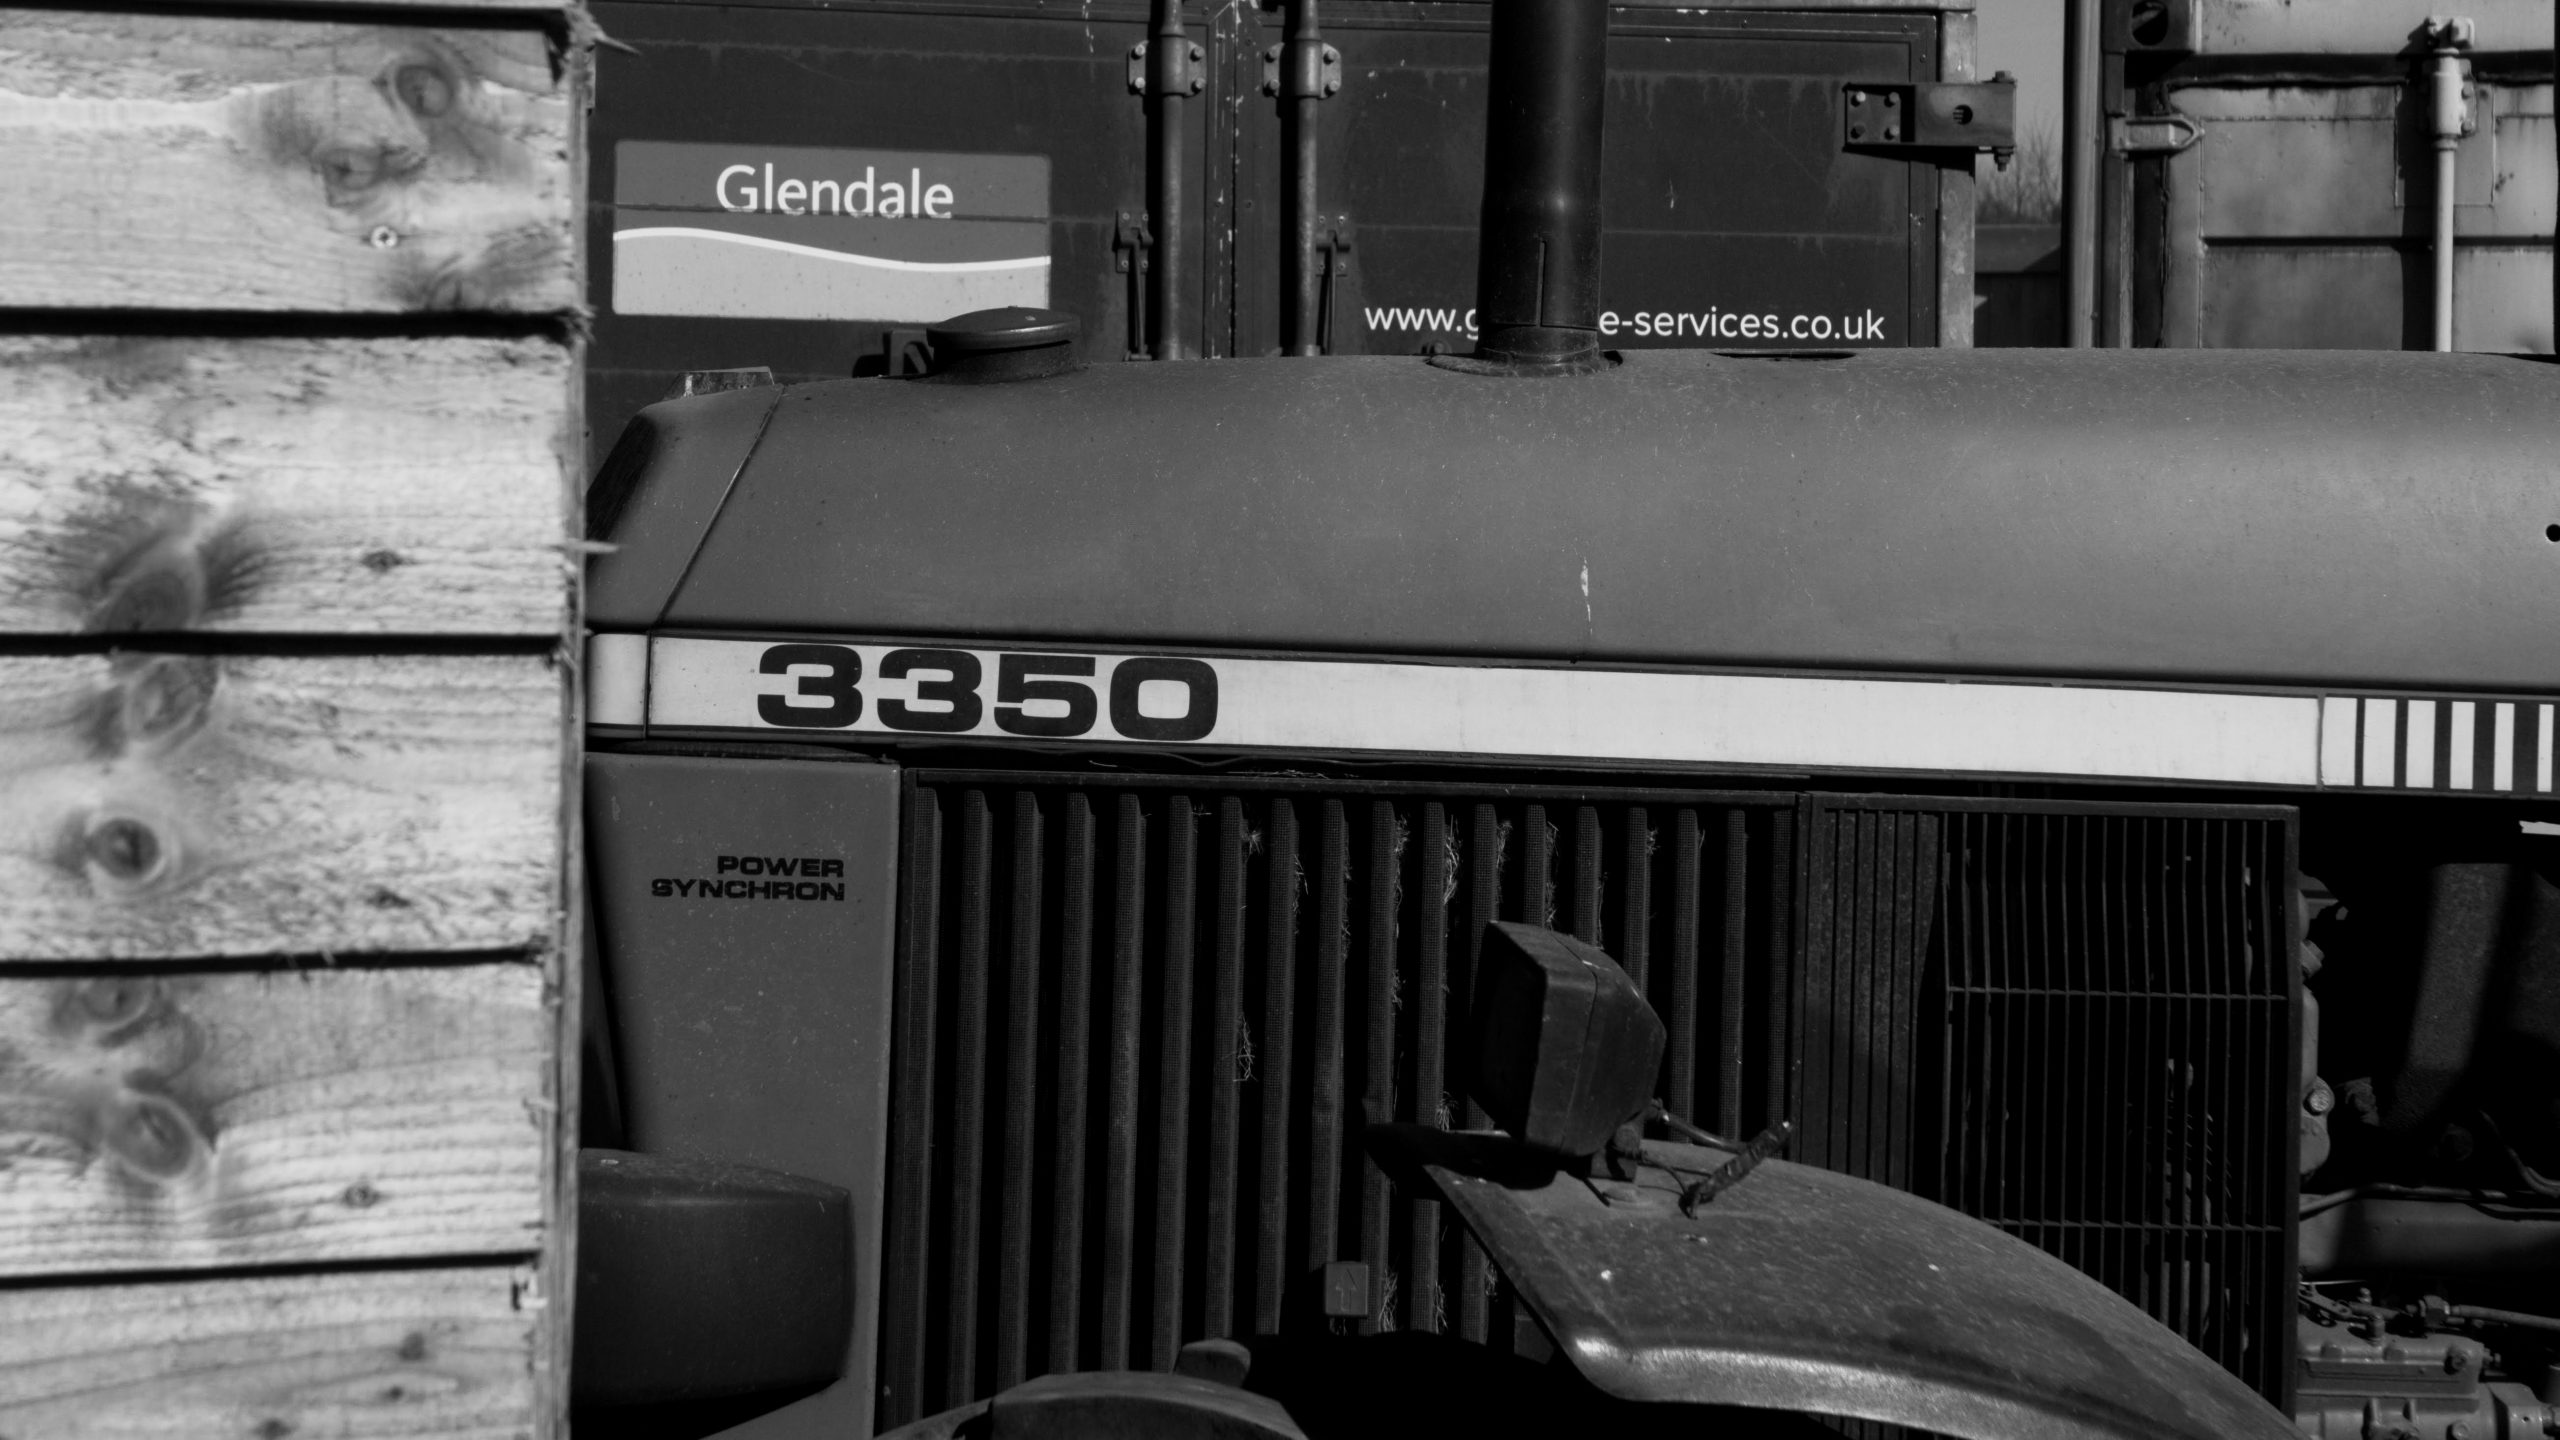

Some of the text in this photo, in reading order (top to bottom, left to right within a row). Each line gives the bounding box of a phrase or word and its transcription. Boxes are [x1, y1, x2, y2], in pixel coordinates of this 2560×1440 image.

[716, 162, 954, 220] Glendale
[757, 643, 1219, 742] 3350
[717, 855, 844, 878] POWER
[651, 878, 845, 901] SYNCHRON
